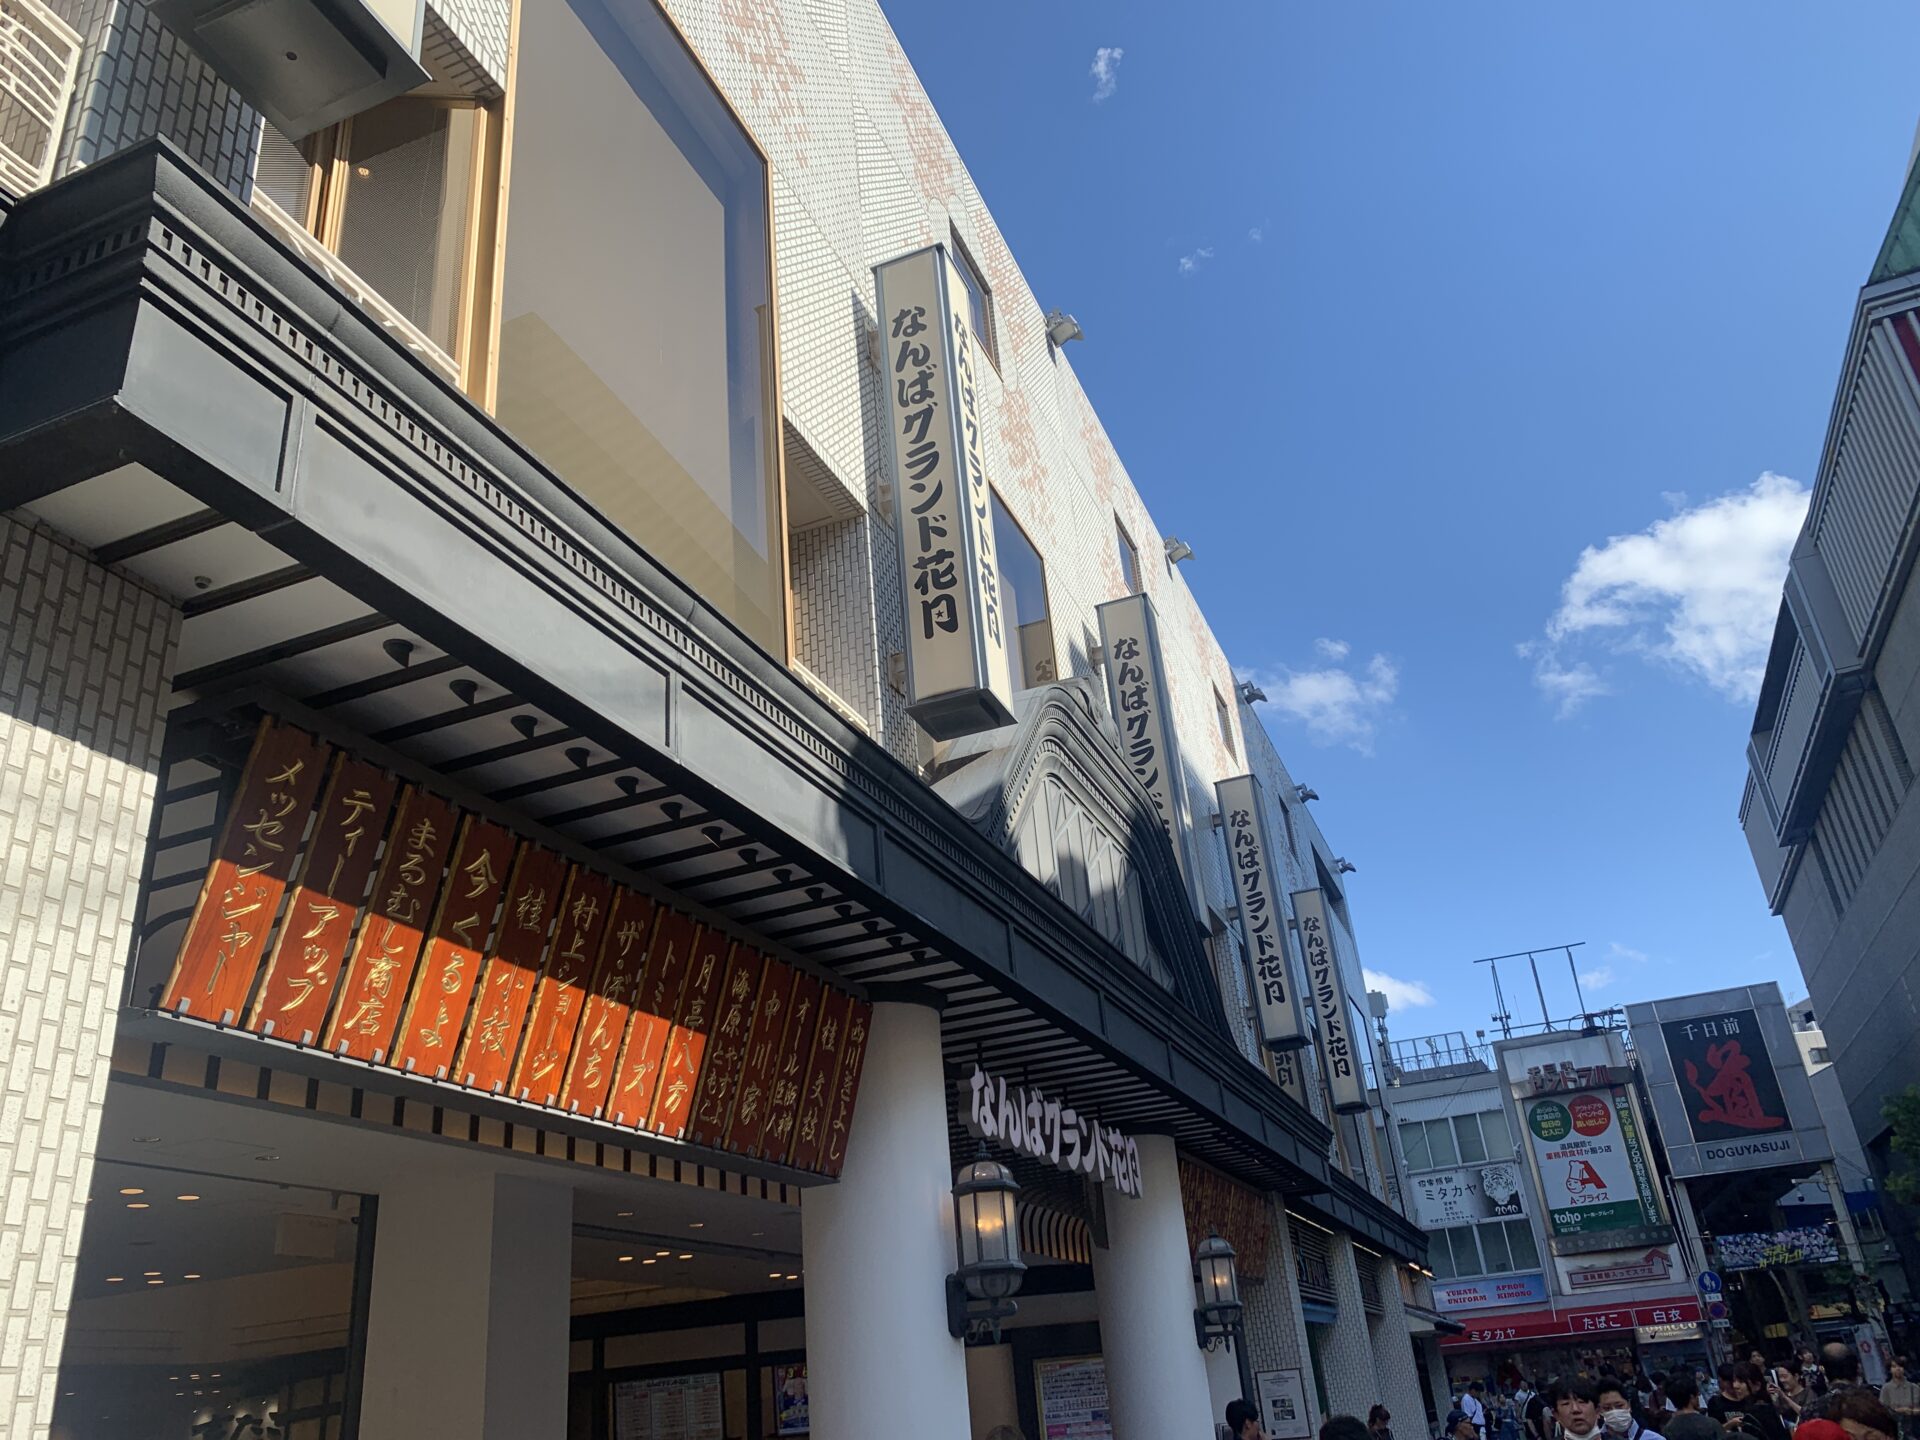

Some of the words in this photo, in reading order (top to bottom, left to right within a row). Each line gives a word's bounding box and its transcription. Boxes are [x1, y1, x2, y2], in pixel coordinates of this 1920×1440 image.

[891, 306, 959, 640] なんばグランド花月
[953, 311, 1002, 650] なんばグランド花月
[207, 759, 304, 995] メッセンジャー
[280, 789, 377, 1011] ティーアップ
[343, 817, 438, 1036] まるむし商店
[1230, 809, 1286, 1006] なんばグランド花月
[419, 848, 498, 1048] 今くるよ
[531, 895, 600, 1082] 村上ショージ
[1303, 916, 1351, 1079] なんばグランド花月
[624, 940, 676, 1097] トミーズ
[664, 954, 717, 1114] 月亭八方
[740, 990, 781, 1126] 中川家
[1680, 1017, 1741, 1041] 千日前
[970, 1063, 1143, 1199] なんばグランド花月
[1425, 1183, 1477, 1201] ミタカヤ
[1706, 1140, 1790, 1160] DOGUYASUJI
[1554, 1211, 1582, 1225] toho
[1446, 1287, 1479, 1297] YUKATA
[1447, 1294, 1488, 1305] UNIFORM
[1470, 1327, 1516, 1342] ミタカヤ
[1496, 1282, 1525, 1291] APRON
[1496, 1290, 1533, 1299] KIMONO
[1583, 1315, 1622, 1331] たばこ
[1653, 1309, 1683, 1323] 白衣
